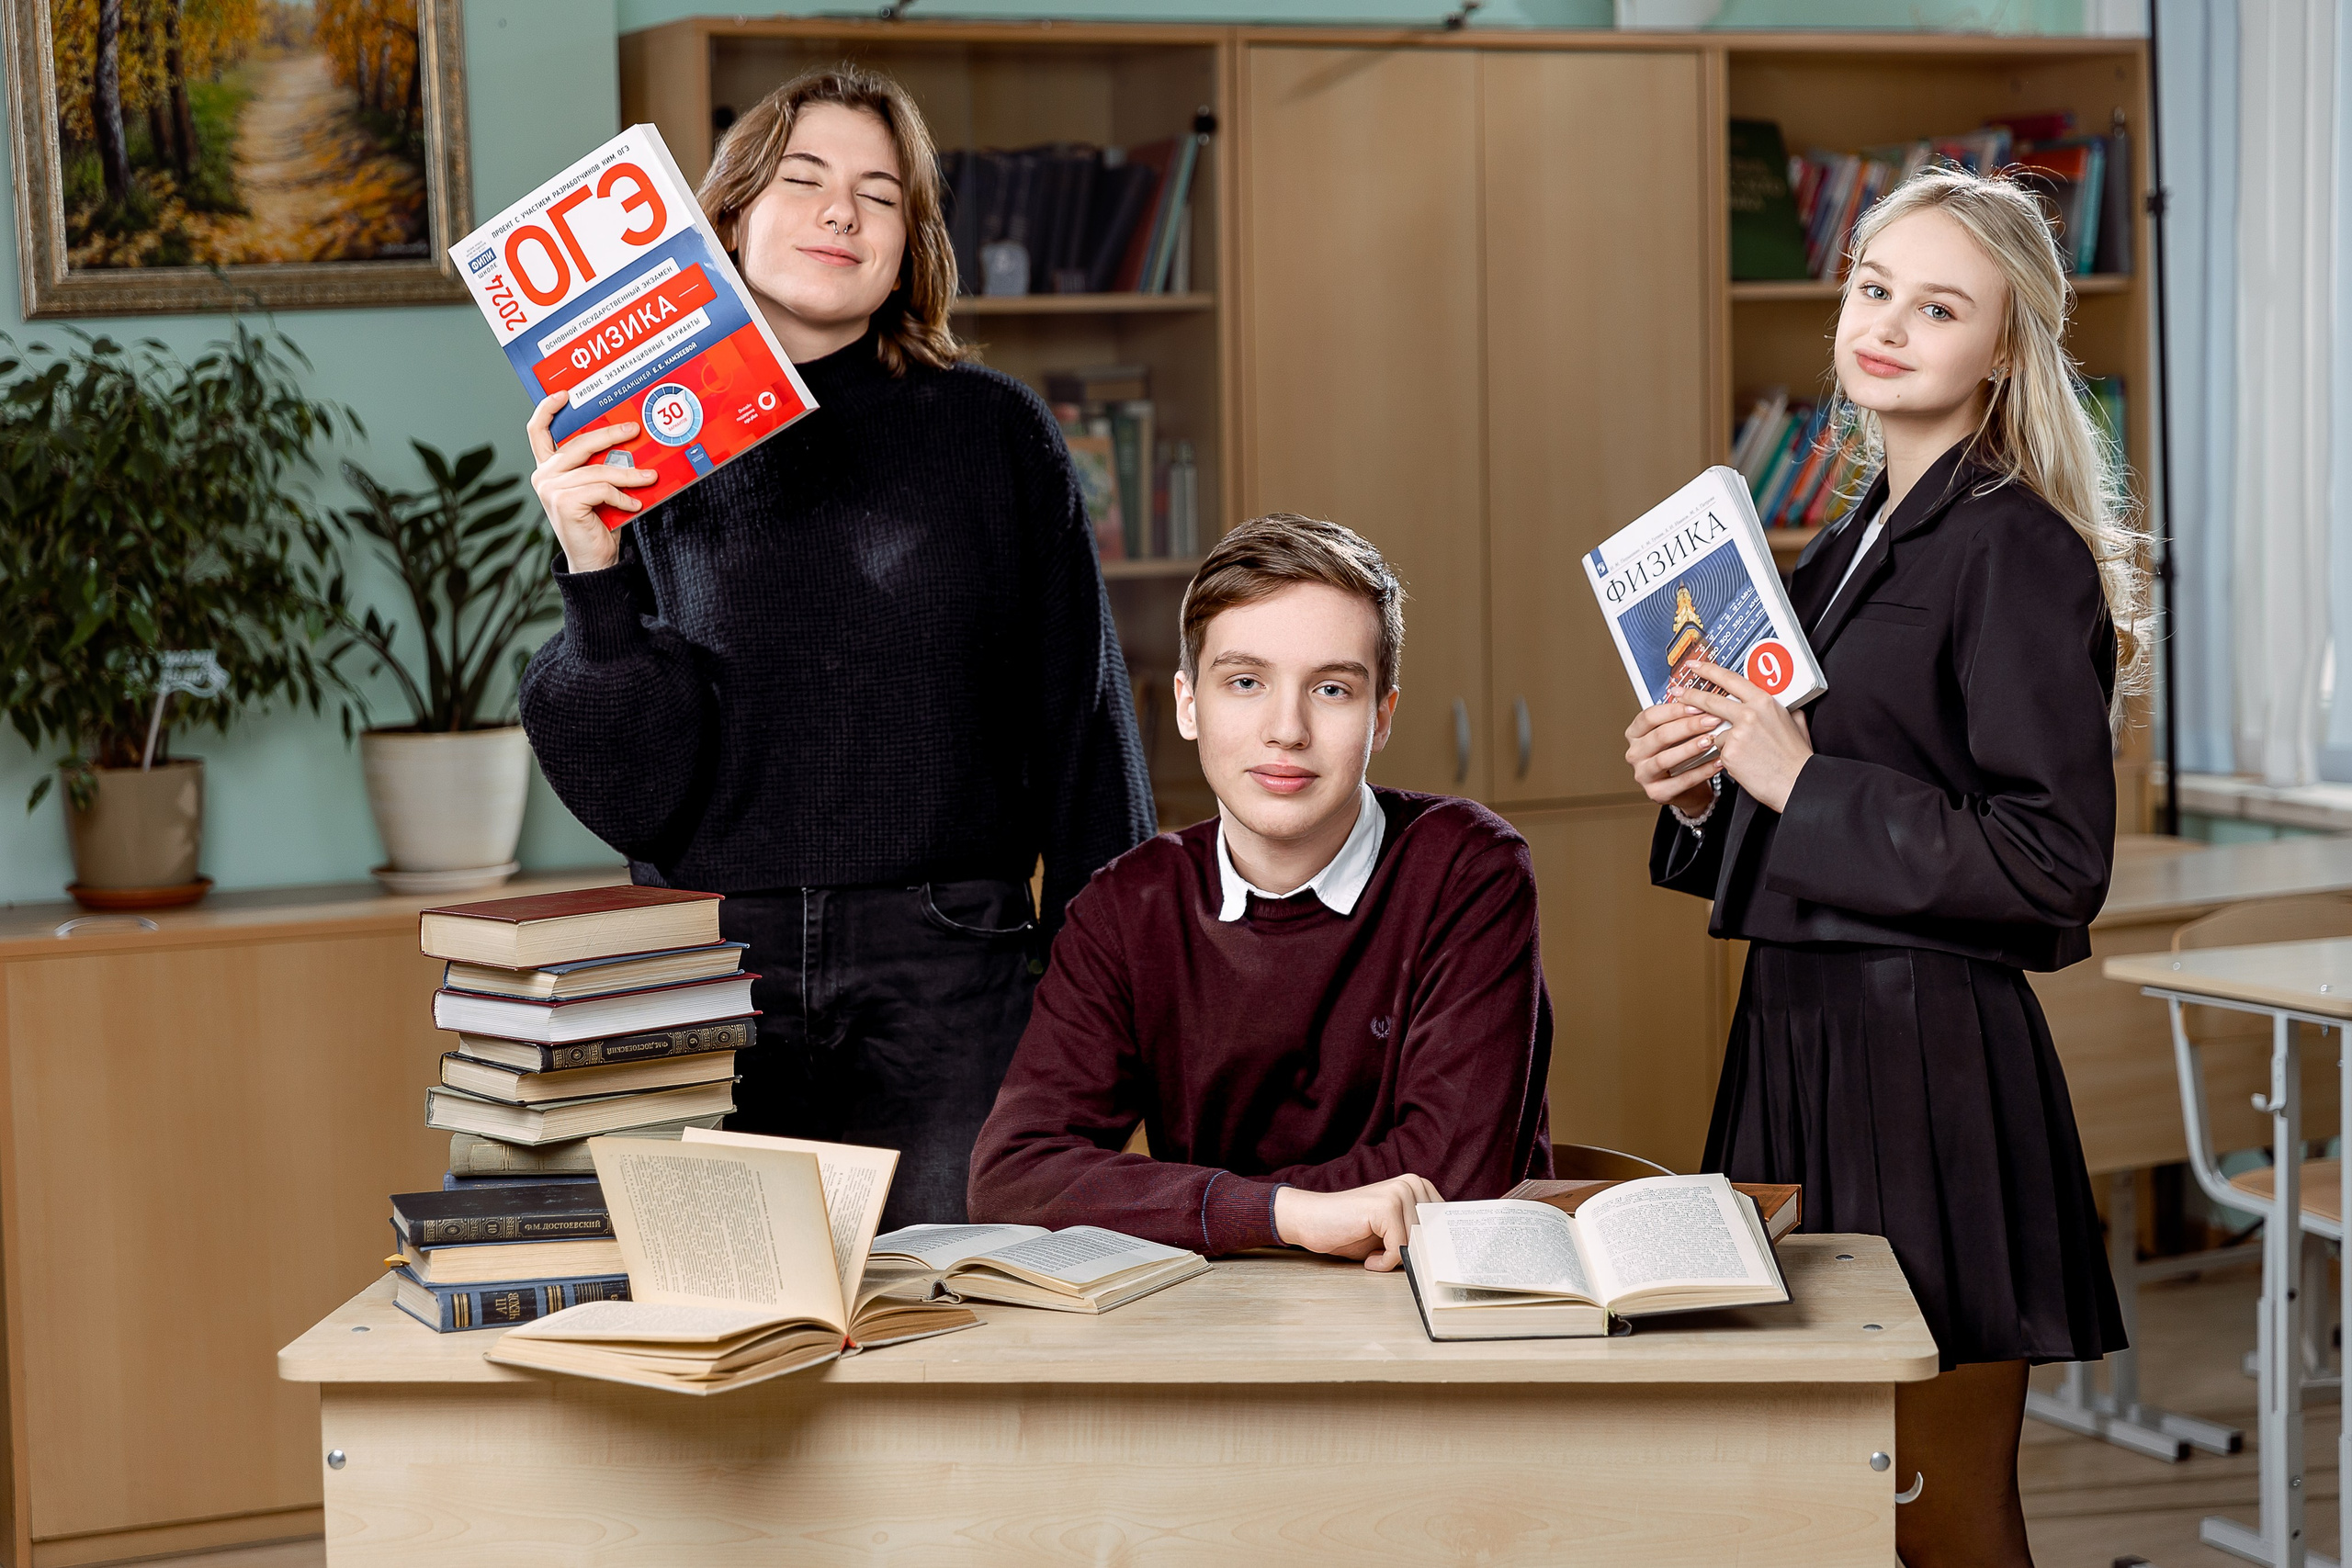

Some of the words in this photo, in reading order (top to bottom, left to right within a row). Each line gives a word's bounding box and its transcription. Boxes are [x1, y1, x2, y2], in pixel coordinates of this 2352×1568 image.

[492, 220, 514, 238] ПРОЕКТ
[521, 196, 551, 220] УЧАСТИЕМ
[552, 164, 601, 198] РАЗРАБОТЧИКОВ
[602, 153, 616, 166] КИМ
[617, 144, 630, 156] ОГЭ
[471, 250, 494, 270] ФИПИ
[504, 163, 667, 306] ОГЭ
[478, 263, 498, 279] ШКОЛЕ
[485, 274, 527, 332] 2024
[545, 325, 578, 351] ОСНОВНОЙ
[579, 285, 641, 329] ГОСУДАРСТВЕННЫЙ
[641, 265, 673, 288] ЭКЗАМЕН
[571, 295, 678, 369] ФИЗИКА
[575, 378, 604, 400] ТИПОВЫЕ
[605, 339, 665, 381] ЭКЗАМЕНАЦИОННЫЕ
[666, 318, 700, 342] ВАРИАНТЫ
[598, 395, 614, 408] ПОД
[614, 370, 652, 398] РЕДАКЦИЕЙ
[664, 342, 698, 367] КАМЗЕЕВОЙ
[657, 401, 684, 425] 30
[1606, 511, 1728, 604] ФИЗИКА
[1707, 646, 1719, 660] 250
[1719, 630, 1731, 646] 300
[1732, 615, 1744, 629] 350
[1757, 650, 1783, 687] 9
[487, 1224, 498, 1234] 10
[542, 1220, 602, 1232] ДОСТОЕВСКИЙ
[509, 1292, 521, 1320] ЧЕХОВ
